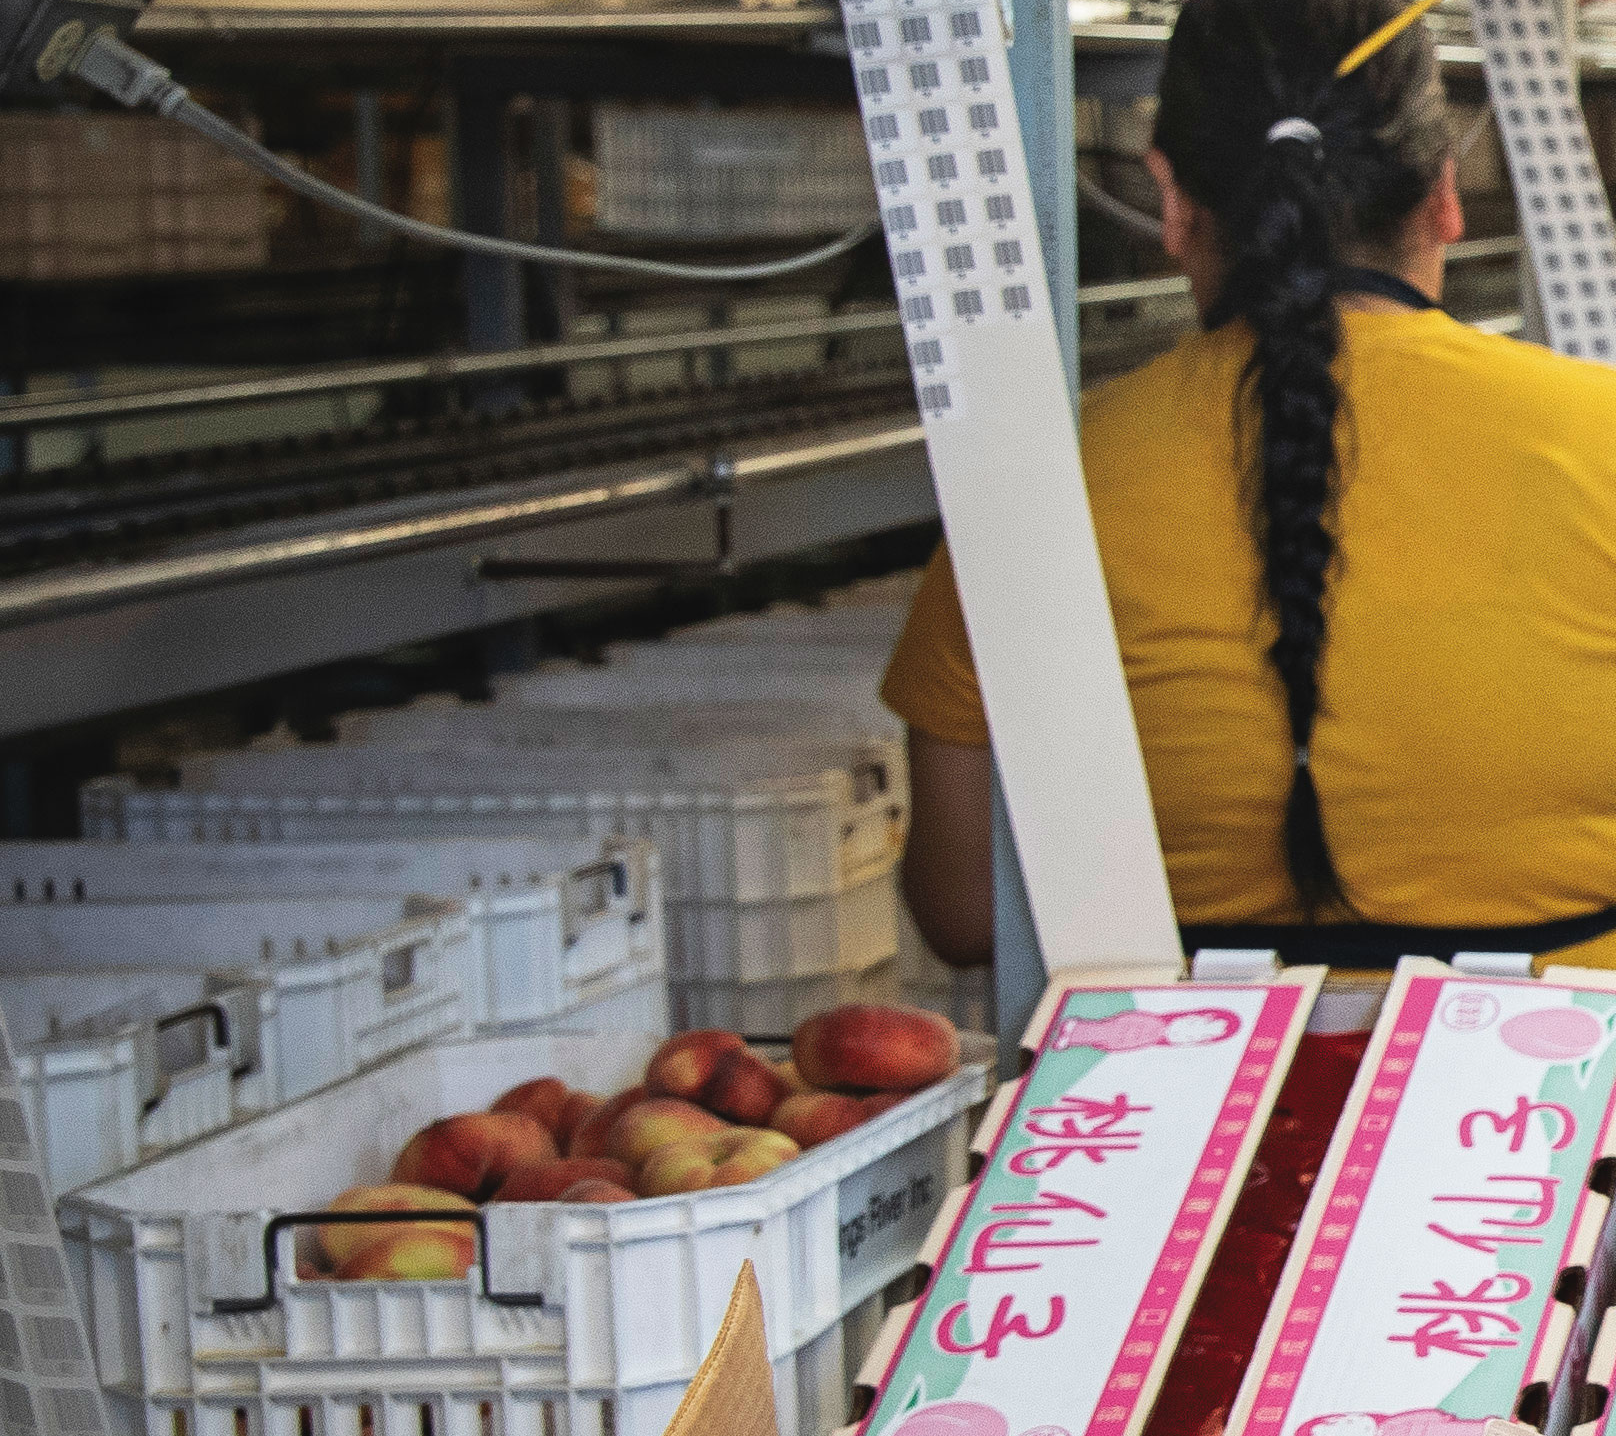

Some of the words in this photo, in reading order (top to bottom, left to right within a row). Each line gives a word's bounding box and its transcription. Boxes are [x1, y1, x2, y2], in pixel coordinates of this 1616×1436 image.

[936, 1091, 1157, 1362] 桃仙子
[1387, 1094, 1580, 1362] 桃仙子
